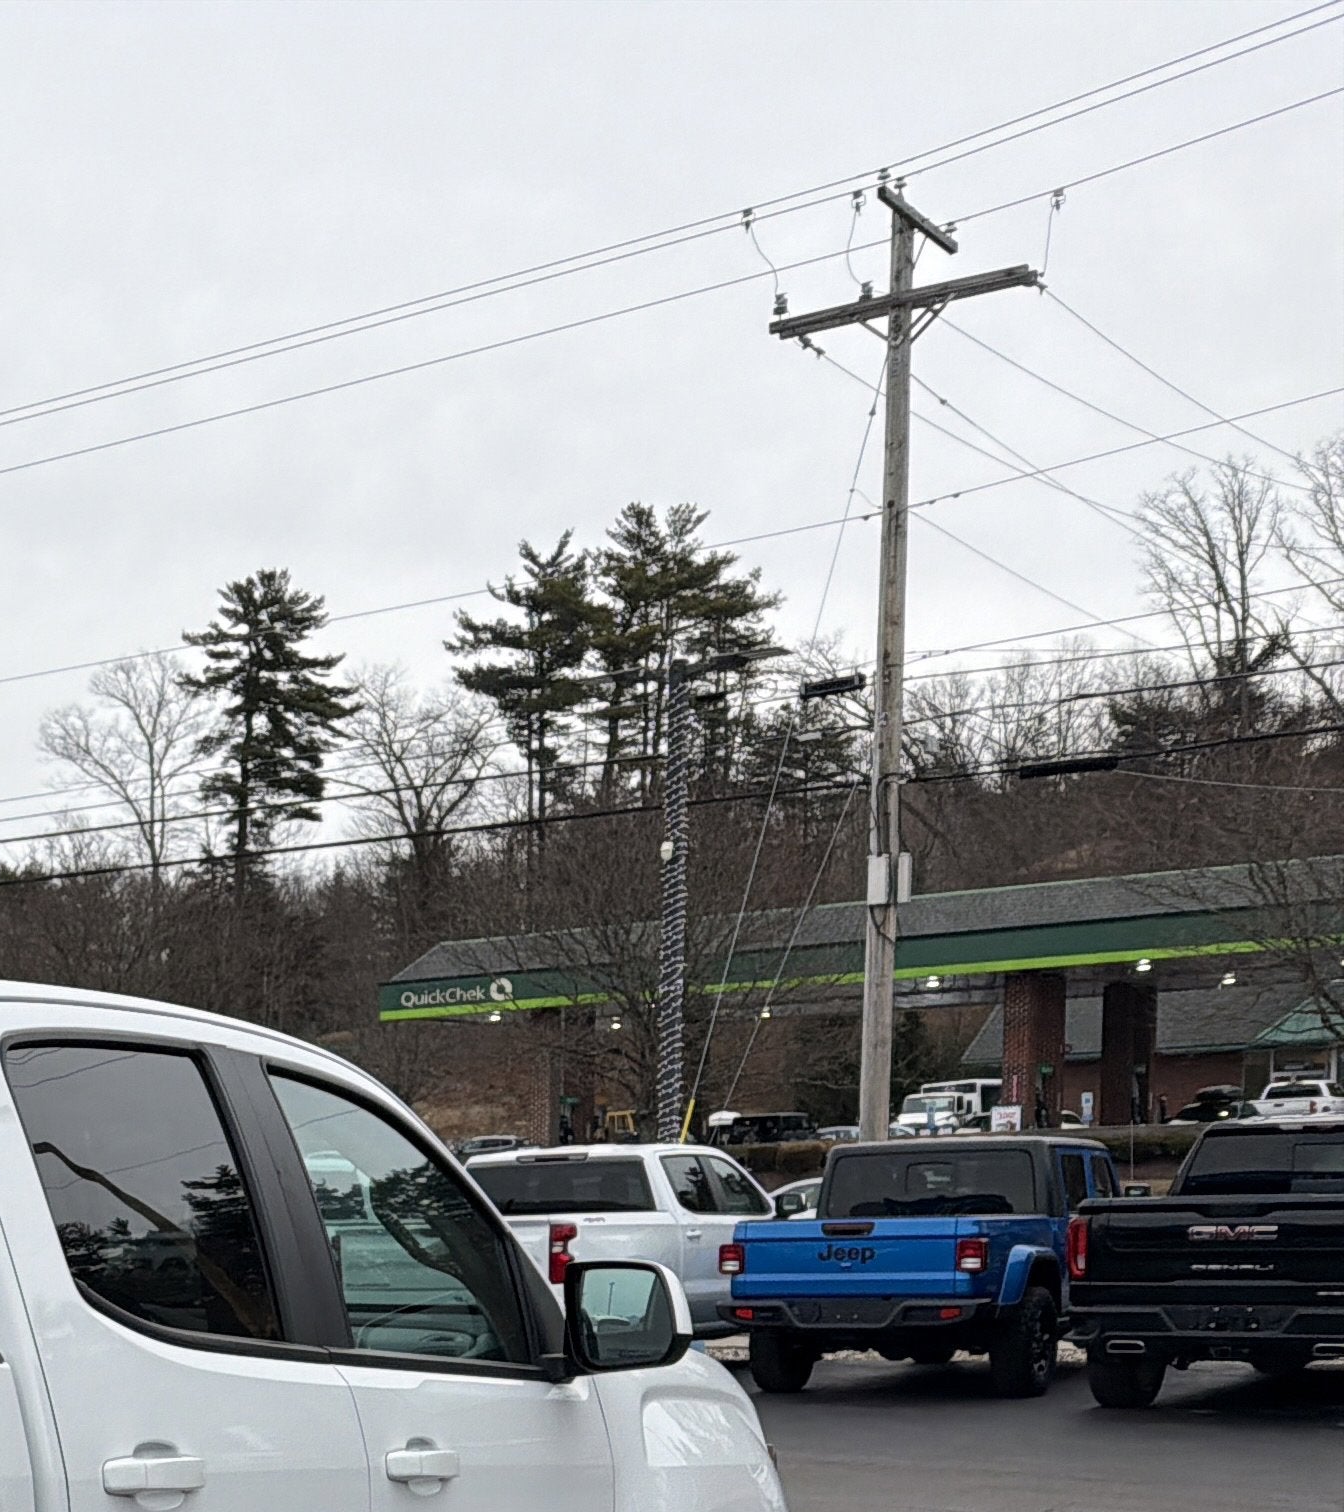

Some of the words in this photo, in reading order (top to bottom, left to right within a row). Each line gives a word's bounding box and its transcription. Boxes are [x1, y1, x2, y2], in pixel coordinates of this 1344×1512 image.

[401, 986, 486, 1008] QuickChek
[1188, 1225, 1279, 1240] GMC
[818, 1244, 875, 1264] Jeep
